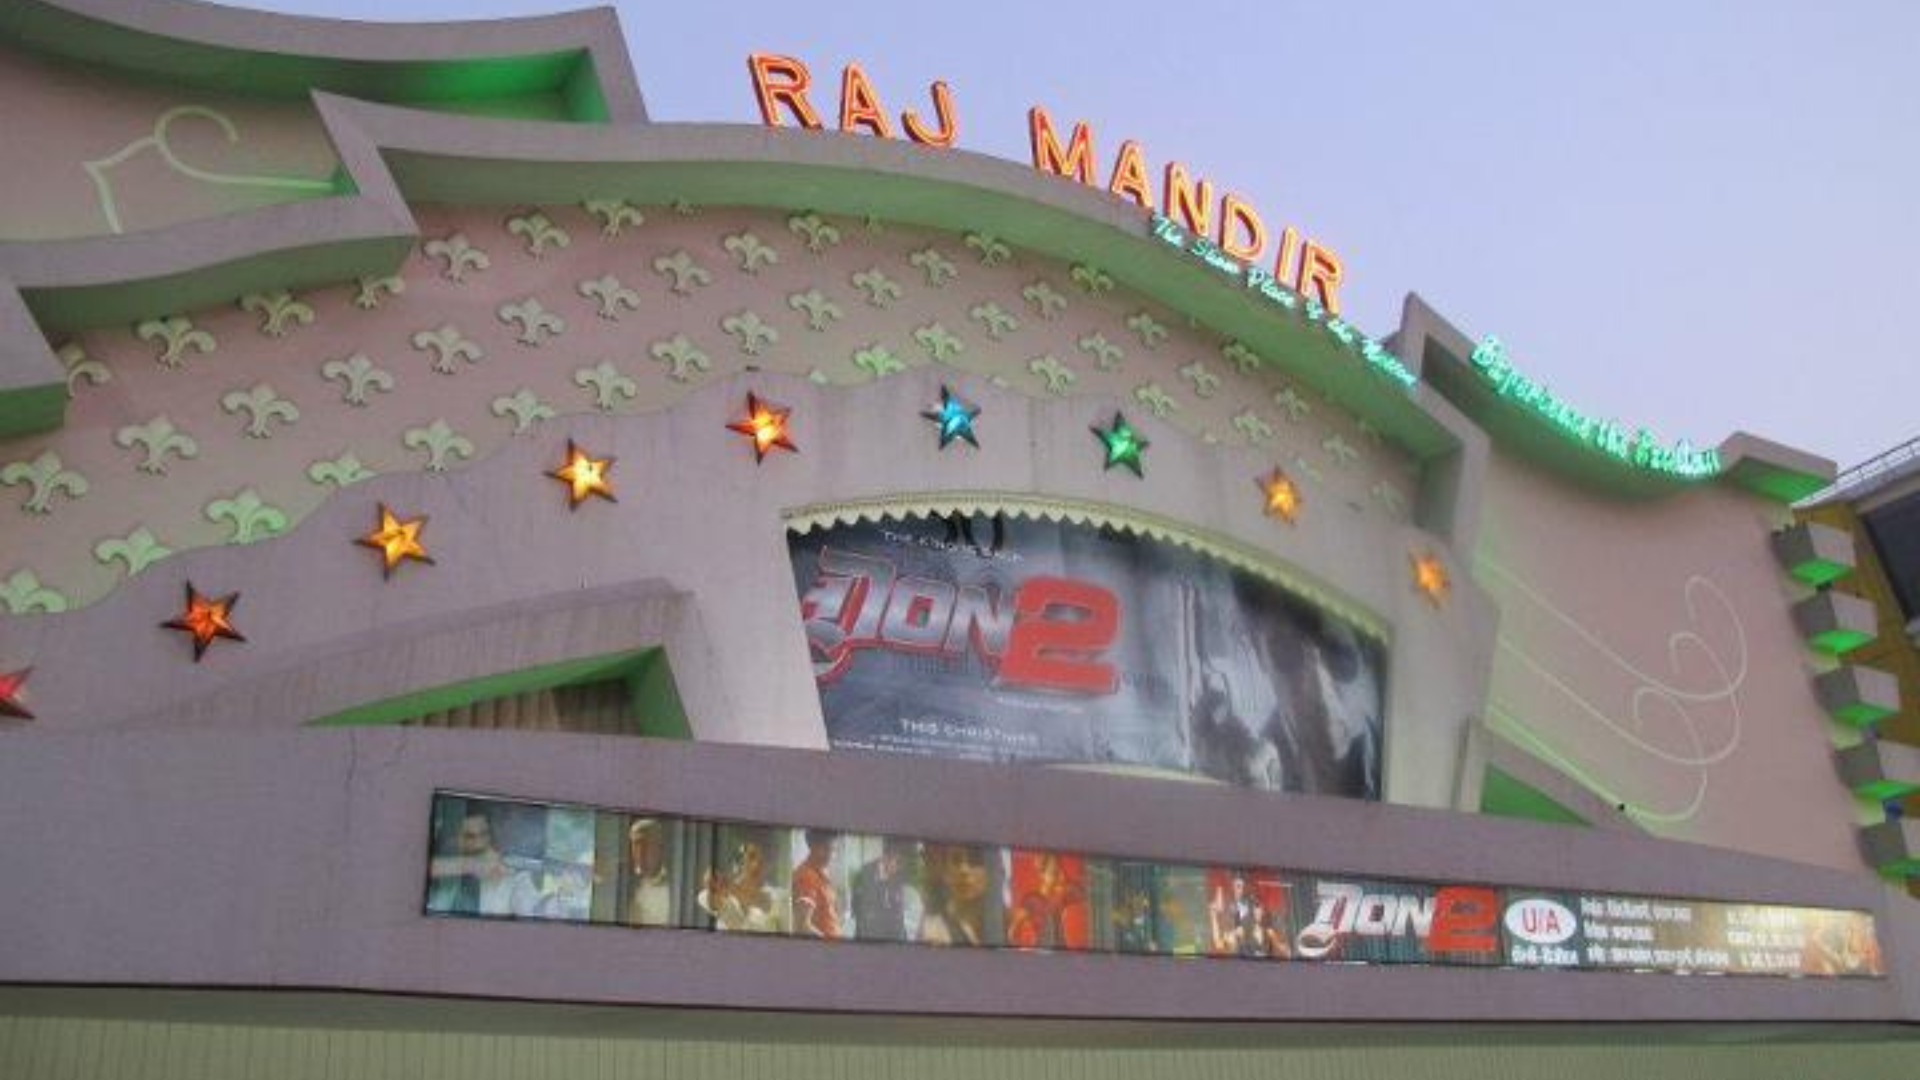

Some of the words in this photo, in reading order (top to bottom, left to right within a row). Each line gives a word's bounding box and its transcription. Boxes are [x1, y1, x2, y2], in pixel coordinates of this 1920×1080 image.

[748, 51, 961, 148] RAJ
[1028, 105, 1346, 315] MANDIR
[994, 574, 1121, 697] 2
[1425, 885, 1499, 955] 2
